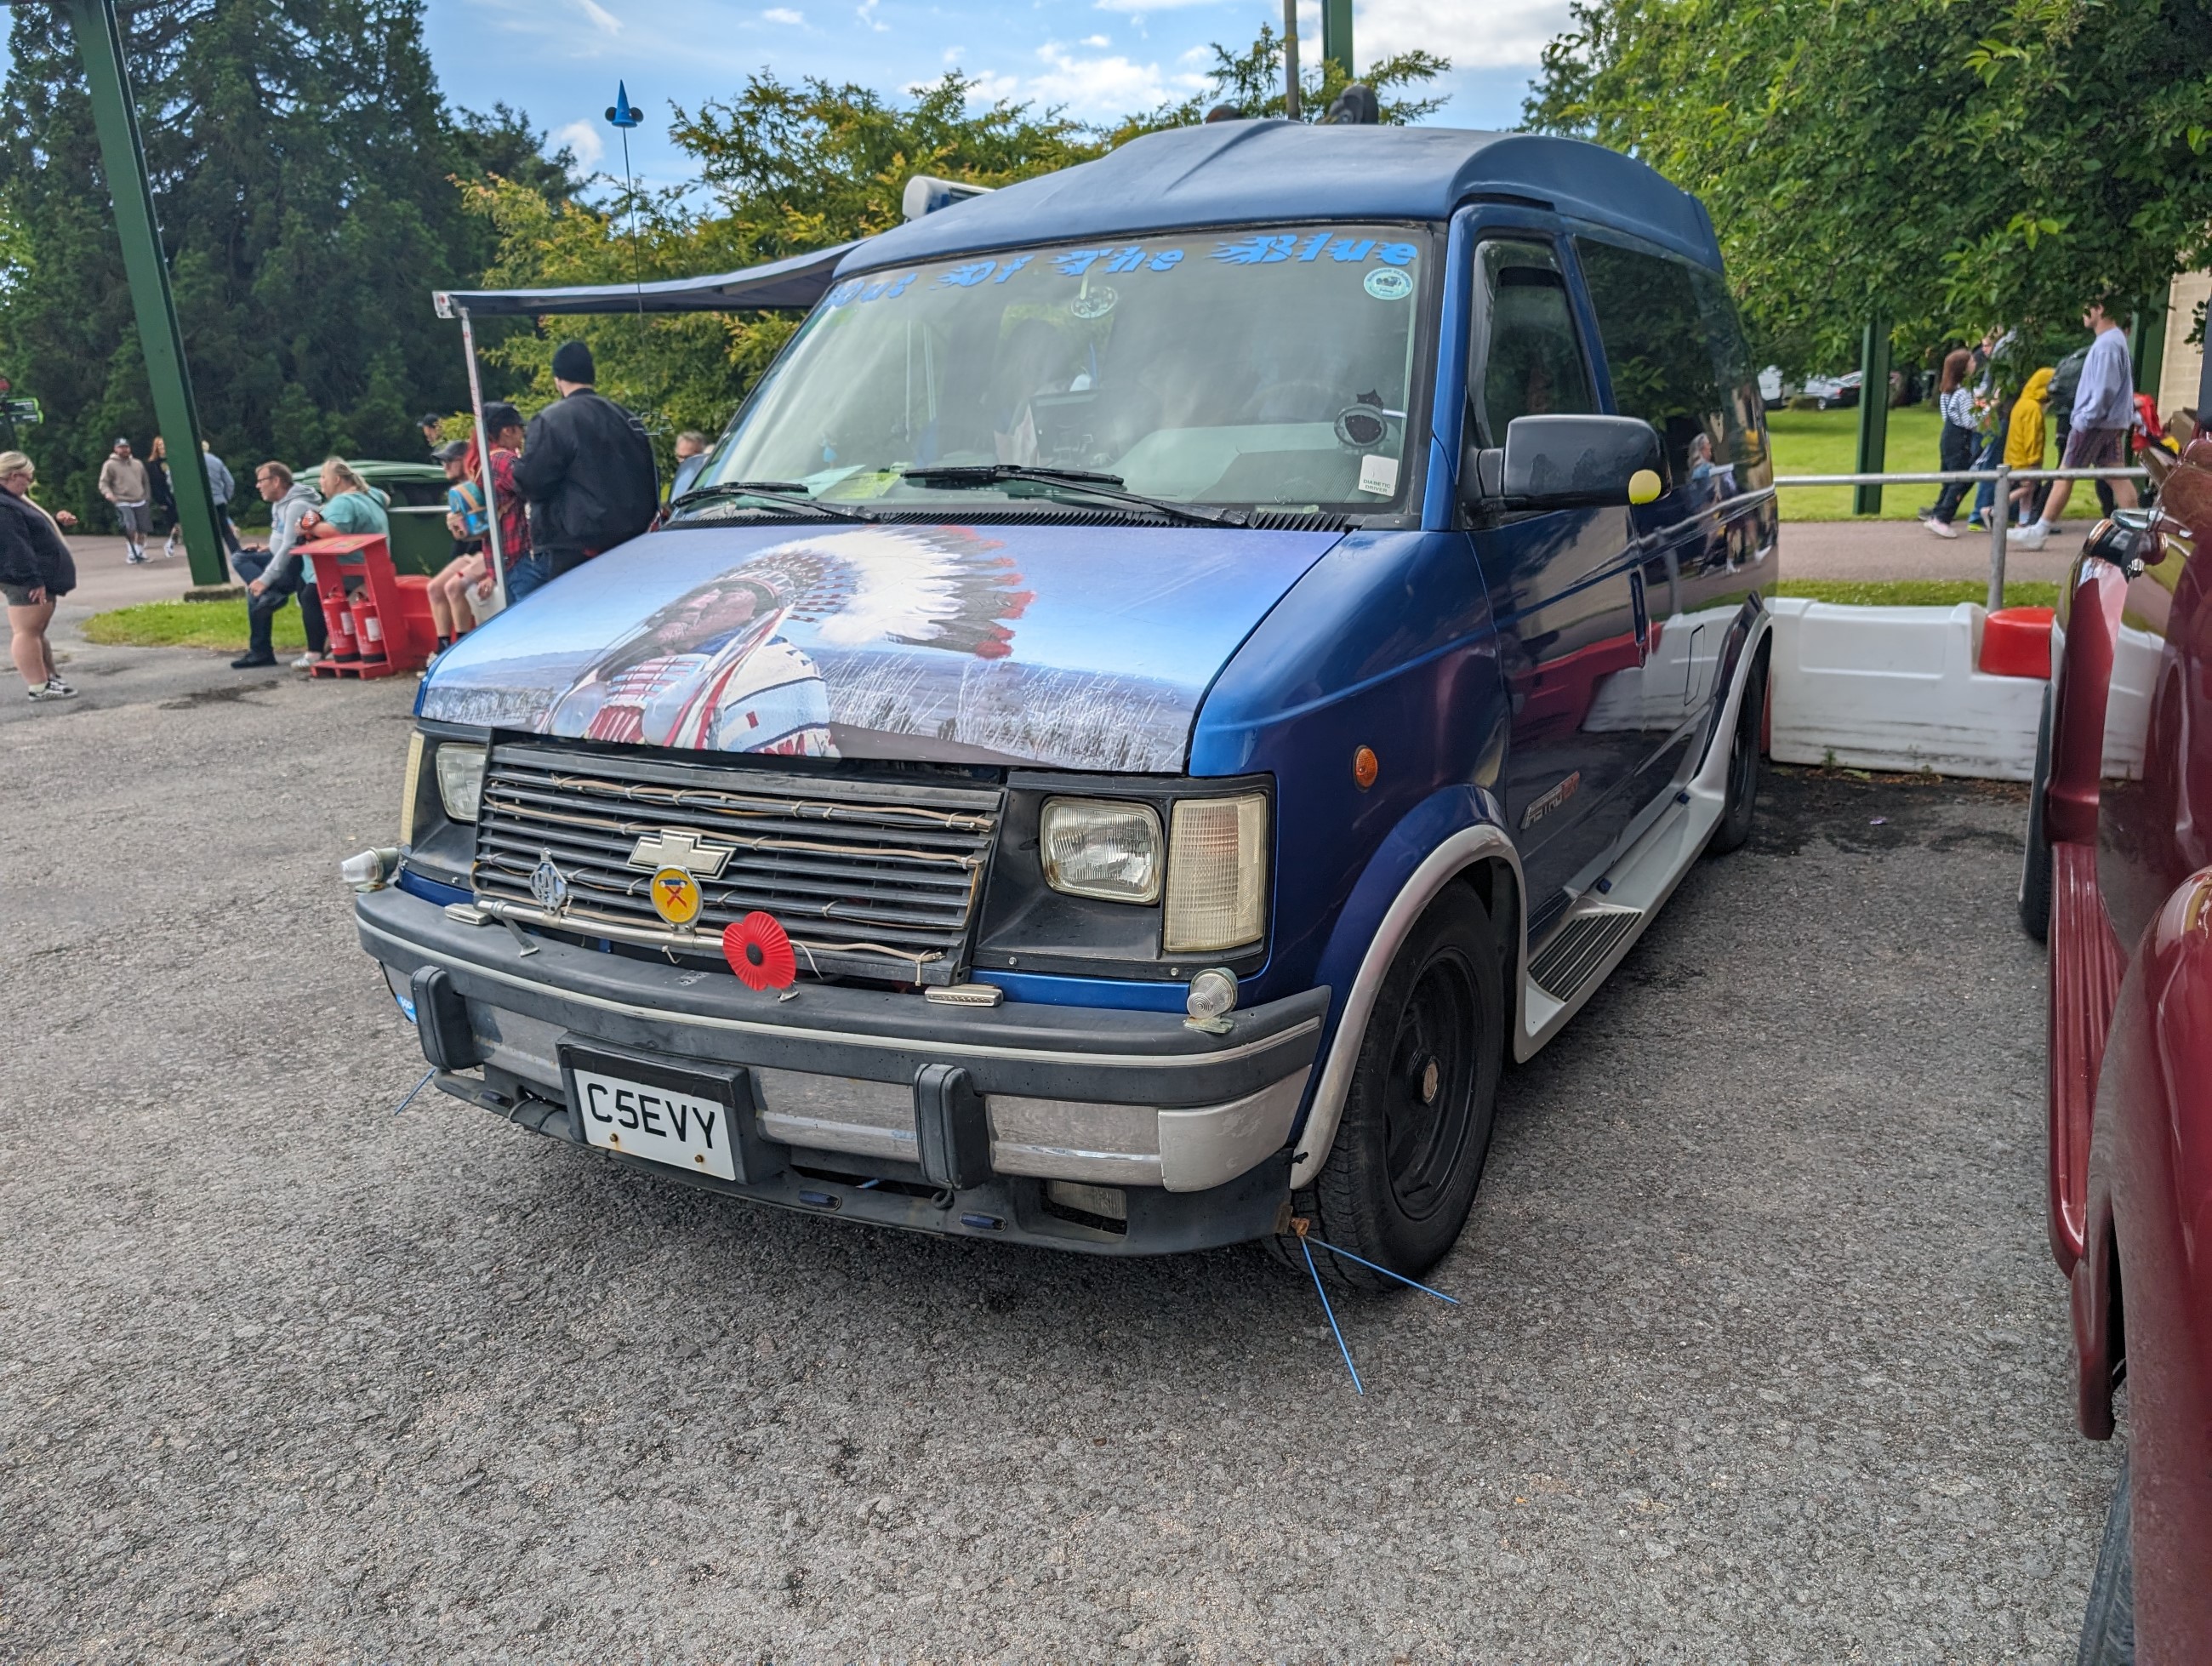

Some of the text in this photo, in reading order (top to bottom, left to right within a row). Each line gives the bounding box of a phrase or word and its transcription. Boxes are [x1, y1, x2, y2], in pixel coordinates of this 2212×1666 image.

[932, 254, 1036, 289] Of
[1047, 246, 1184, 277] The
[1208, 231, 1419, 266] Blue
[1363, 478, 1391, 488] DIABETIC
[586, 1081, 716, 1150] C5EVY
